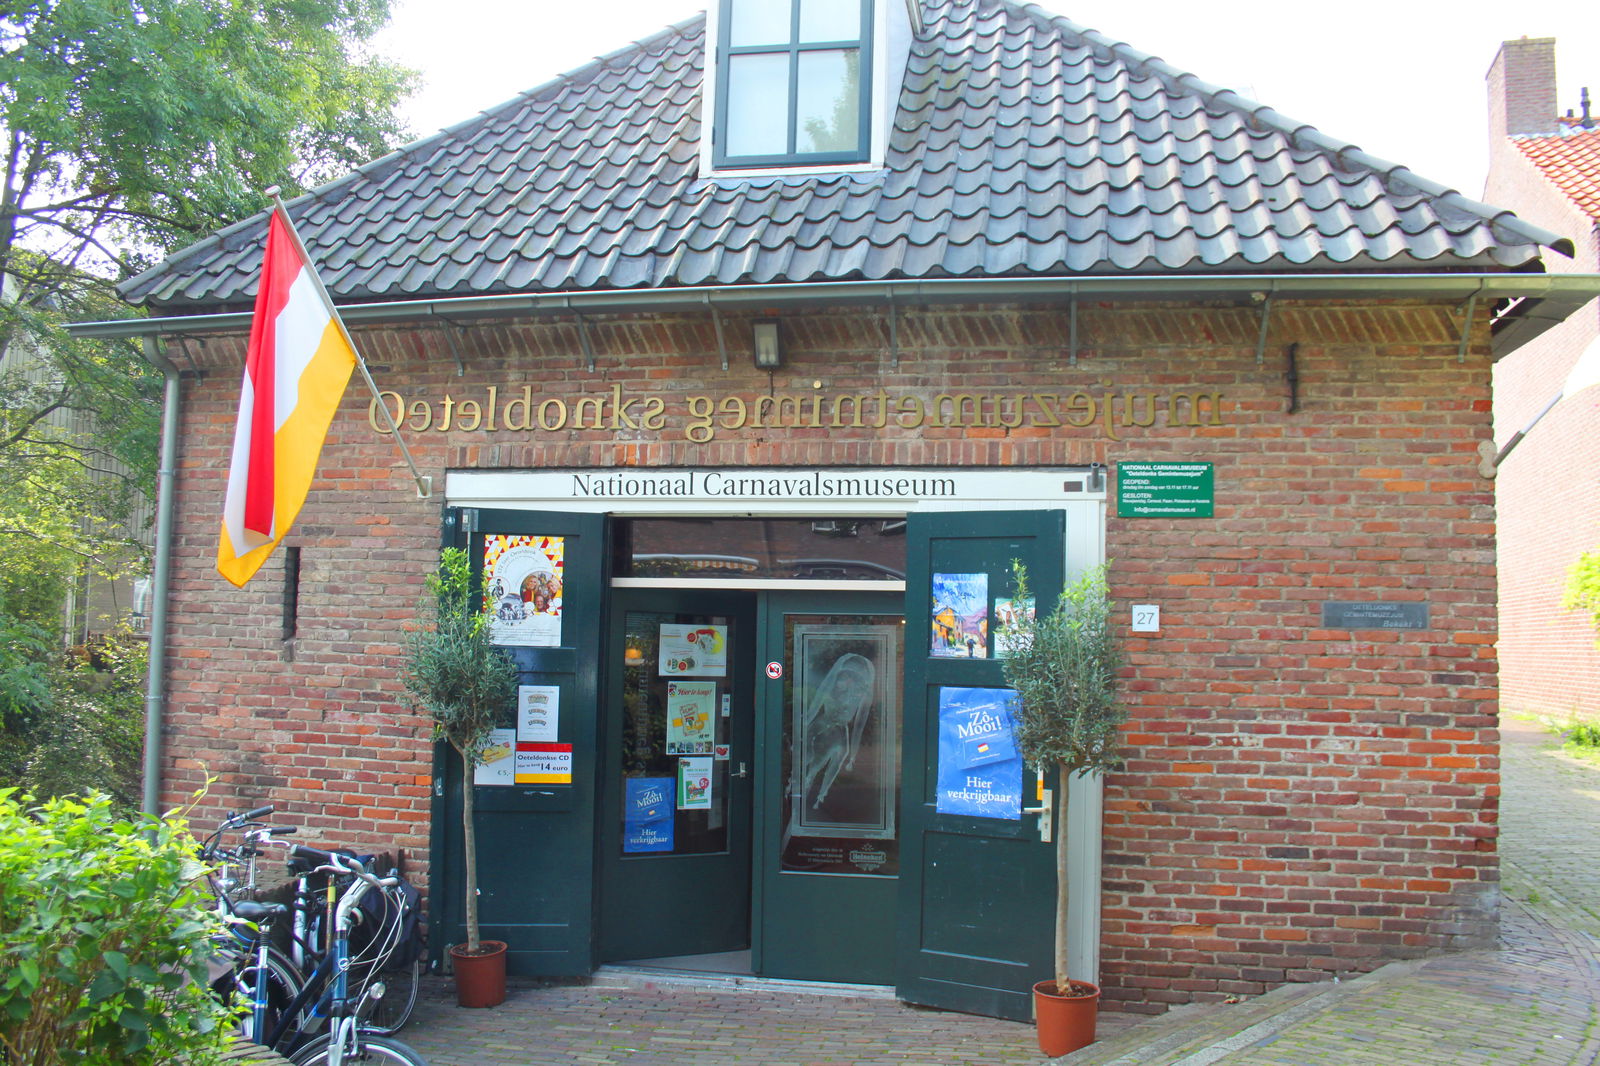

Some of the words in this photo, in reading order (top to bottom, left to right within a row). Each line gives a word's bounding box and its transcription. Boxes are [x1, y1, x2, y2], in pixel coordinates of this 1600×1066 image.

[572, 472, 695, 498] Nationaal
[703, 472, 956, 498] Carnavalsmuseum
[1136, 611, 1155, 626] 27
[957, 715, 1003, 739] Mooi!
[541, 762, 551, 771] 14
[966, 776, 993, 789] Hier
[636, 792, 663, 808] Mooi!
[947, 787, 1012, 805] verkrijgbaar
[642, 828, 657, 836] Hier
[630, 835, 669, 846] verkrijgbaar
[852, 853, 883, 861] Heineken
